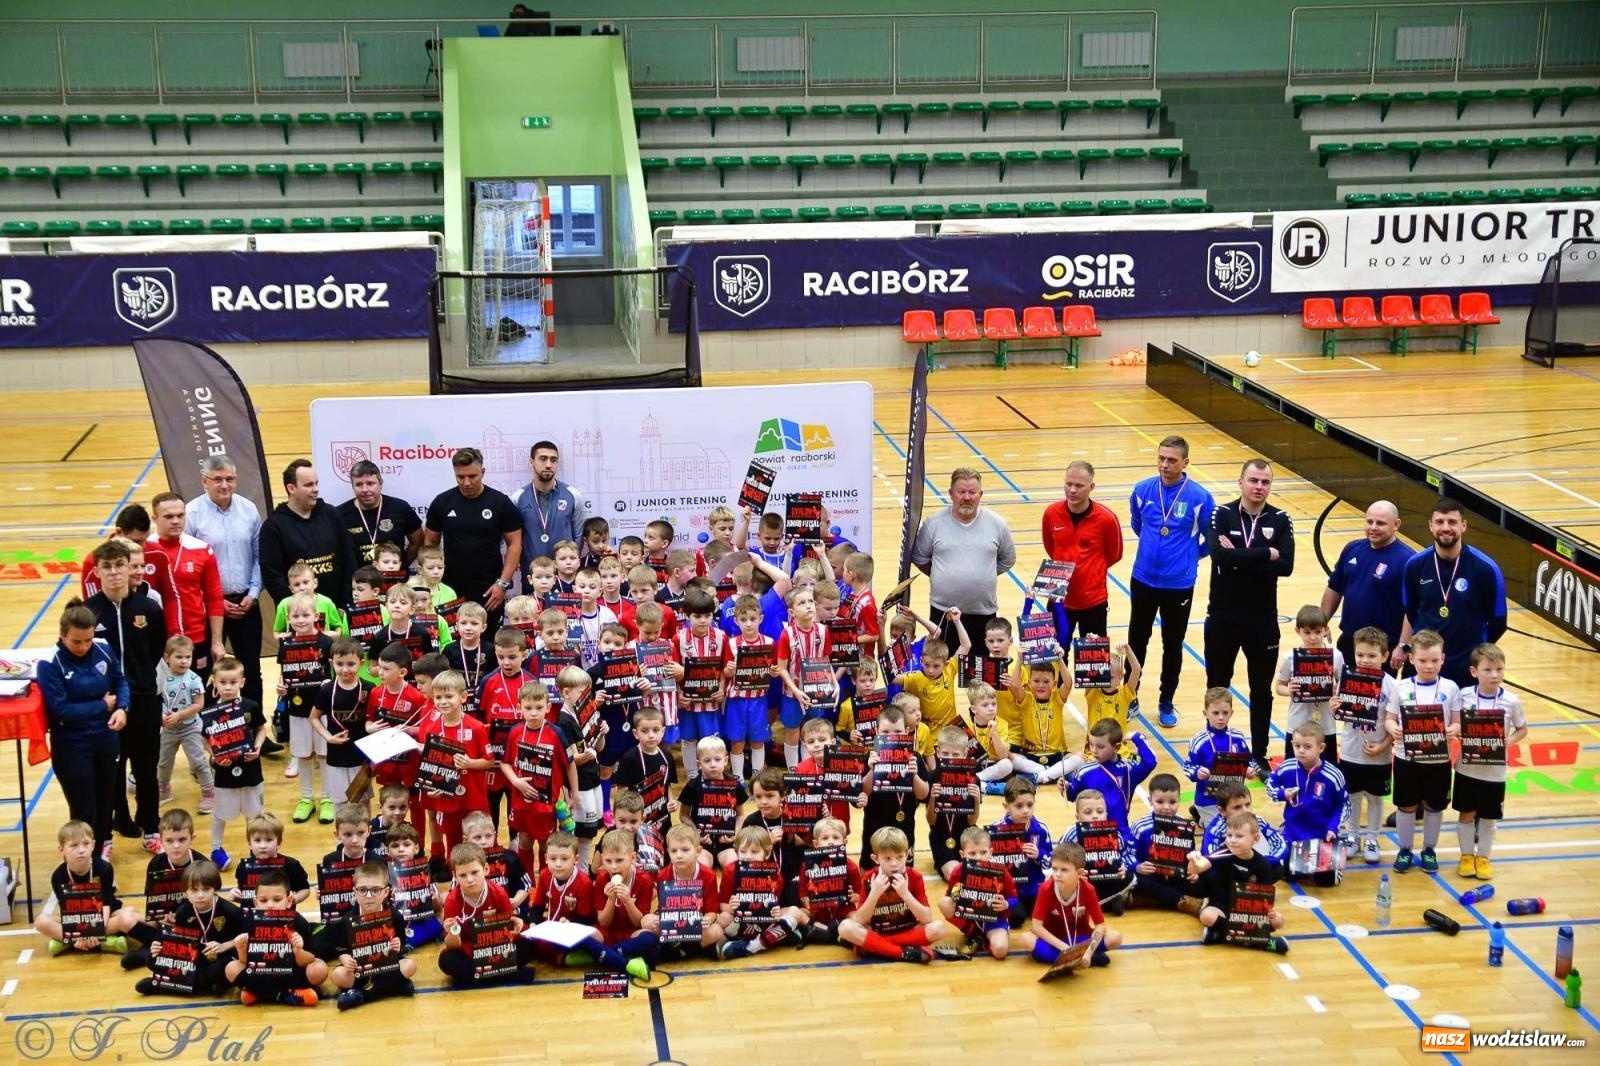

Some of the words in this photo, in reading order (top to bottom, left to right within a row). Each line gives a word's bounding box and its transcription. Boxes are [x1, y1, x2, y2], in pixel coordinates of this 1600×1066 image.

[1370, 211, 1528, 246] JUNIOR
[1369, 252, 1466, 268] ROZWÓJ
[1482, 248, 1600, 264] MŁODGO
[803, 262, 969, 297] RACIBÓRZ
[210, 275, 390, 313] RACIBÓRZ
[1078, 285, 1135, 299] RACIBÓRZ
[379, 444, 460, 461] Racibór
[753, 454, 785, 464] powiat
[790, 451, 836, 463] raciborski
[636, 498, 677, 507] JUNIOR
[679, 496, 727, 505] TRENING
[666, 896, 692, 909] DYPLOM
[661, 911, 680, 922] JUNIOR
[680, 910, 702, 921] FUTSAL
[248, 942, 268, 953] JUNIOR
[268, 942, 292, 953] FUTSAL
[352, 944, 372, 959] JUNIOR
[372, 940, 391, 951] FUTSA
[473, 946, 492, 959] JUNIOR
[492, 943, 514, 955] FUTSAL
